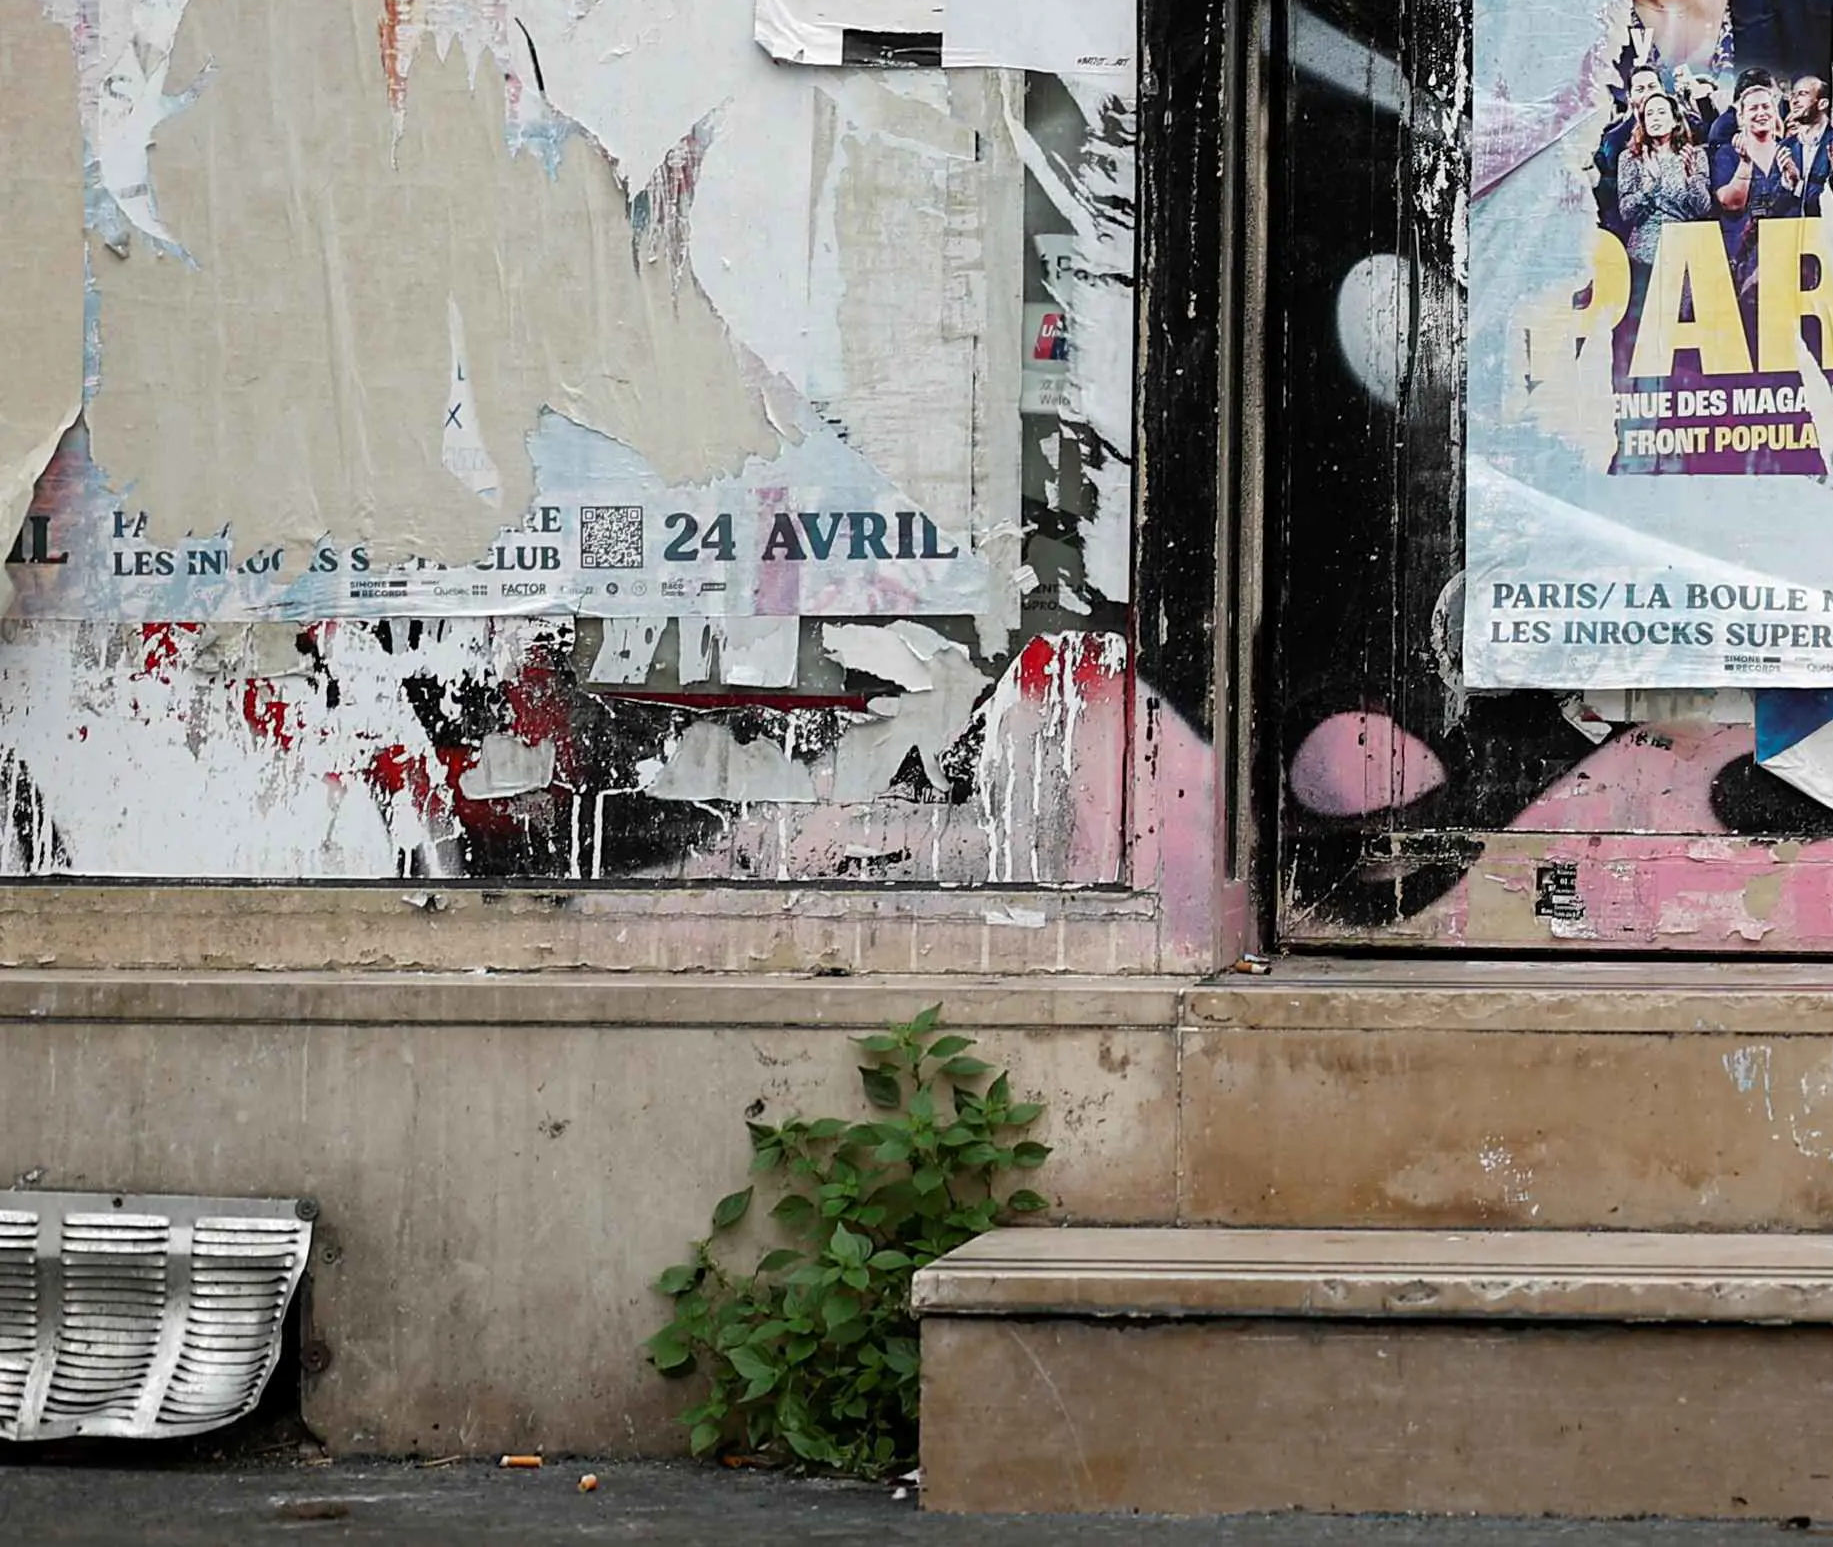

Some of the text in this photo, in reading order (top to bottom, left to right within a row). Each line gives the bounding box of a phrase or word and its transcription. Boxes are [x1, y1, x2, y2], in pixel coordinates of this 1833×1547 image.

[1677, 388, 1727, 416] DES
[1624, 426, 1711, 456] FRONT
[664, 512, 959, 562] 24 AVRIL
[1626, 583, 1672, 611] LA
[1686, 584, 1809, 612] BOULE
[1490, 621, 1551, 646] LES
[1563, 621, 1714, 648] INROCKS
[1725, 622, 1833, 649] SUPER
